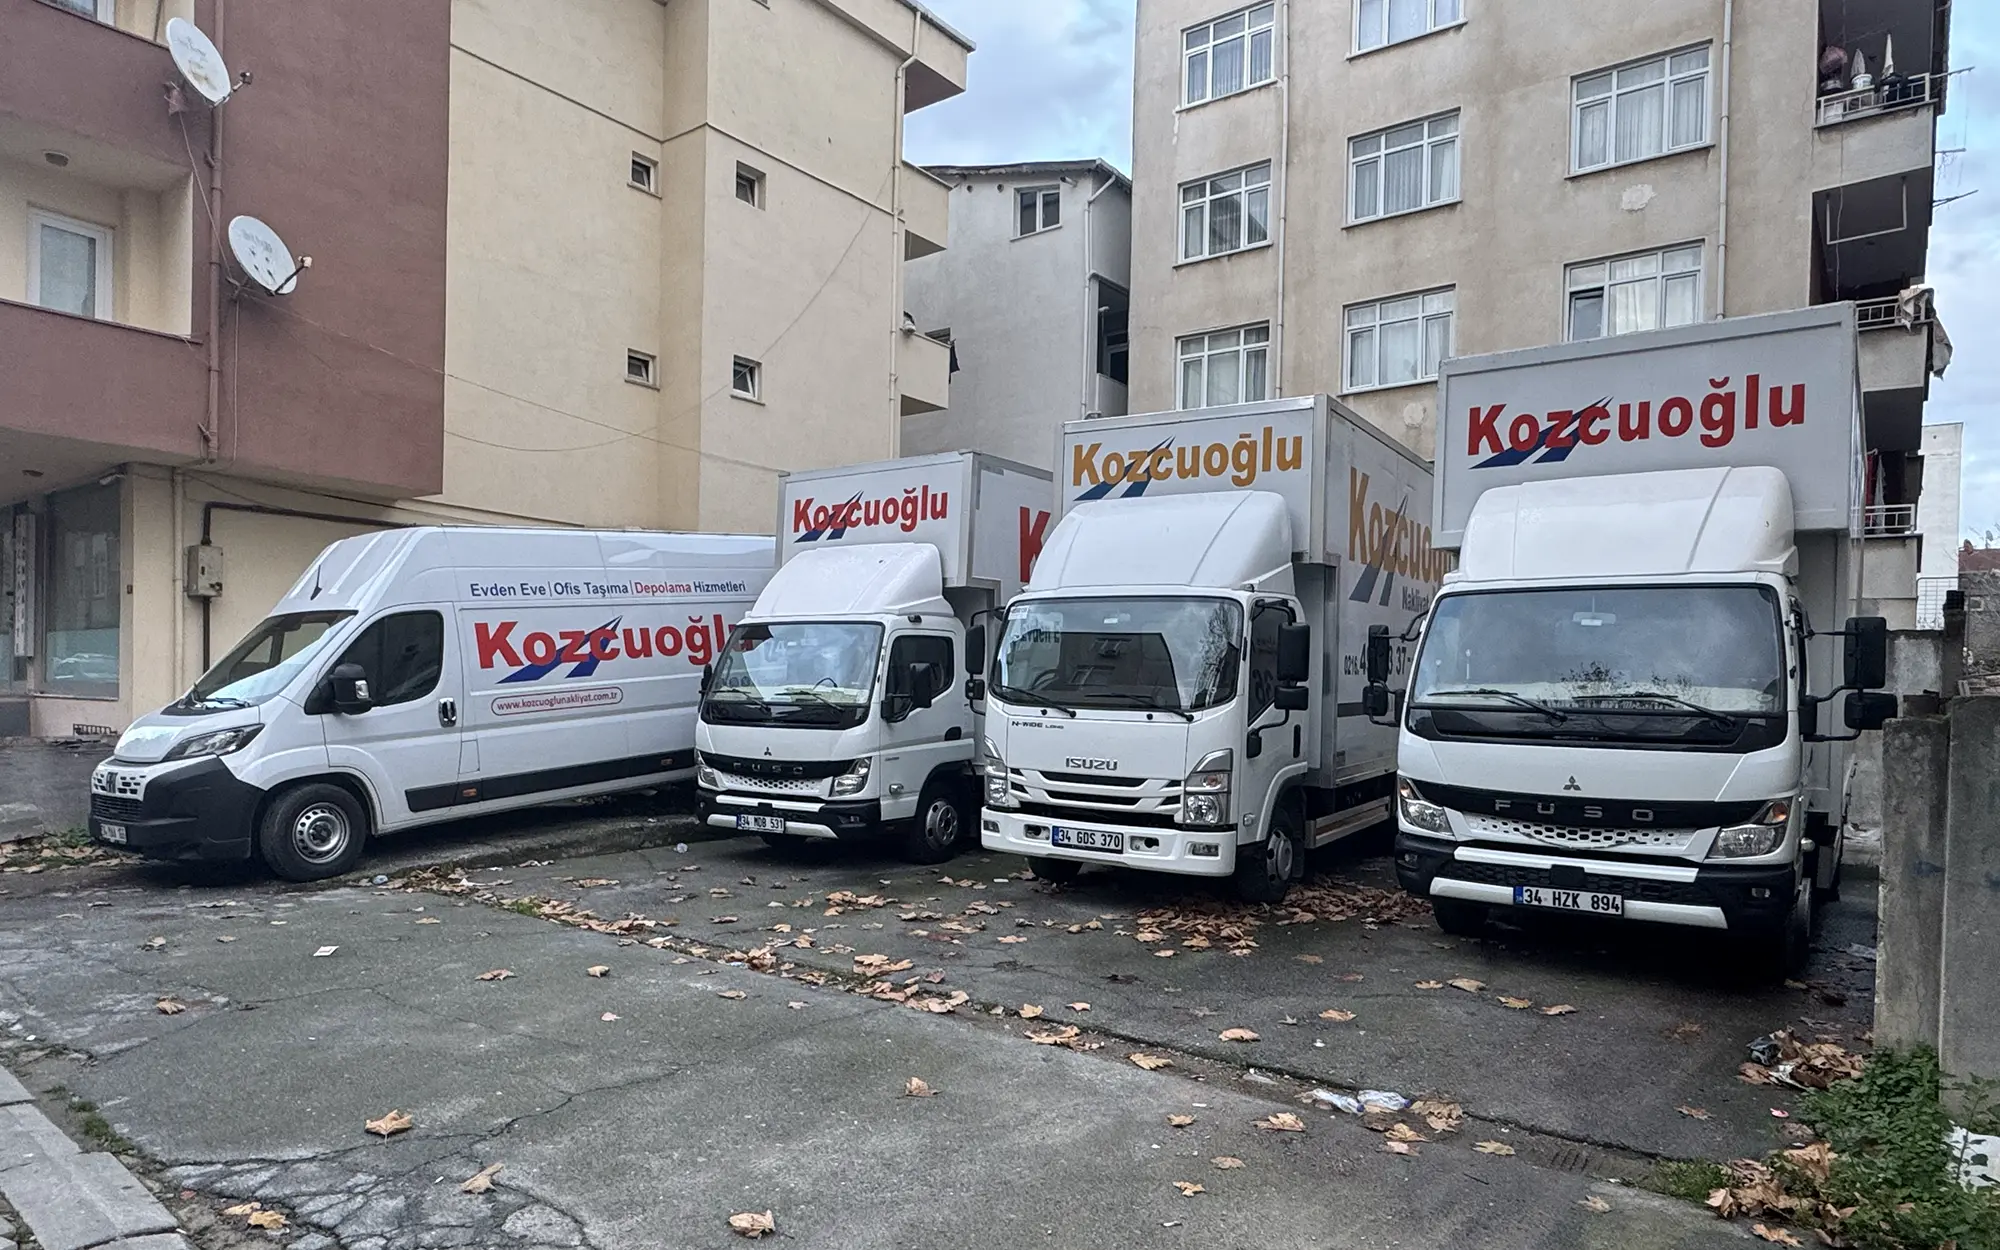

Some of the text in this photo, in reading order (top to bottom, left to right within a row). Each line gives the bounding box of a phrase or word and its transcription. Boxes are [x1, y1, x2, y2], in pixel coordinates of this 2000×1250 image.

[1468, 374, 1805, 456] Kozcuoğlu
[793, 485, 948, 533] Kozcuoğlu
[470, 580, 746, 598] Evden Eve Ofis Taşıma Depolama Hizmetleri
[496, 691, 618, 711] www.kozcuoglunakliyat.com.tr
[1011, 720, 1043, 728] N-WIDE
[733, 762, 803, 775] FUSO
[1066, 756, 1118, 771] ISUZU
[1495, 800, 1654, 822] FUSO
[741, 815, 750, 826] 34
[770, 818, 783, 829] 531
[1059, 829, 1071, 842] 34
[1077, 831, 1096, 845] GDS
[1100, 833, 1120, 848] 370
[1525, 889, 1542, 904] 34
[1552, 891, 1580, 908] HZK
[1591, 894, 1620, 912] 894
